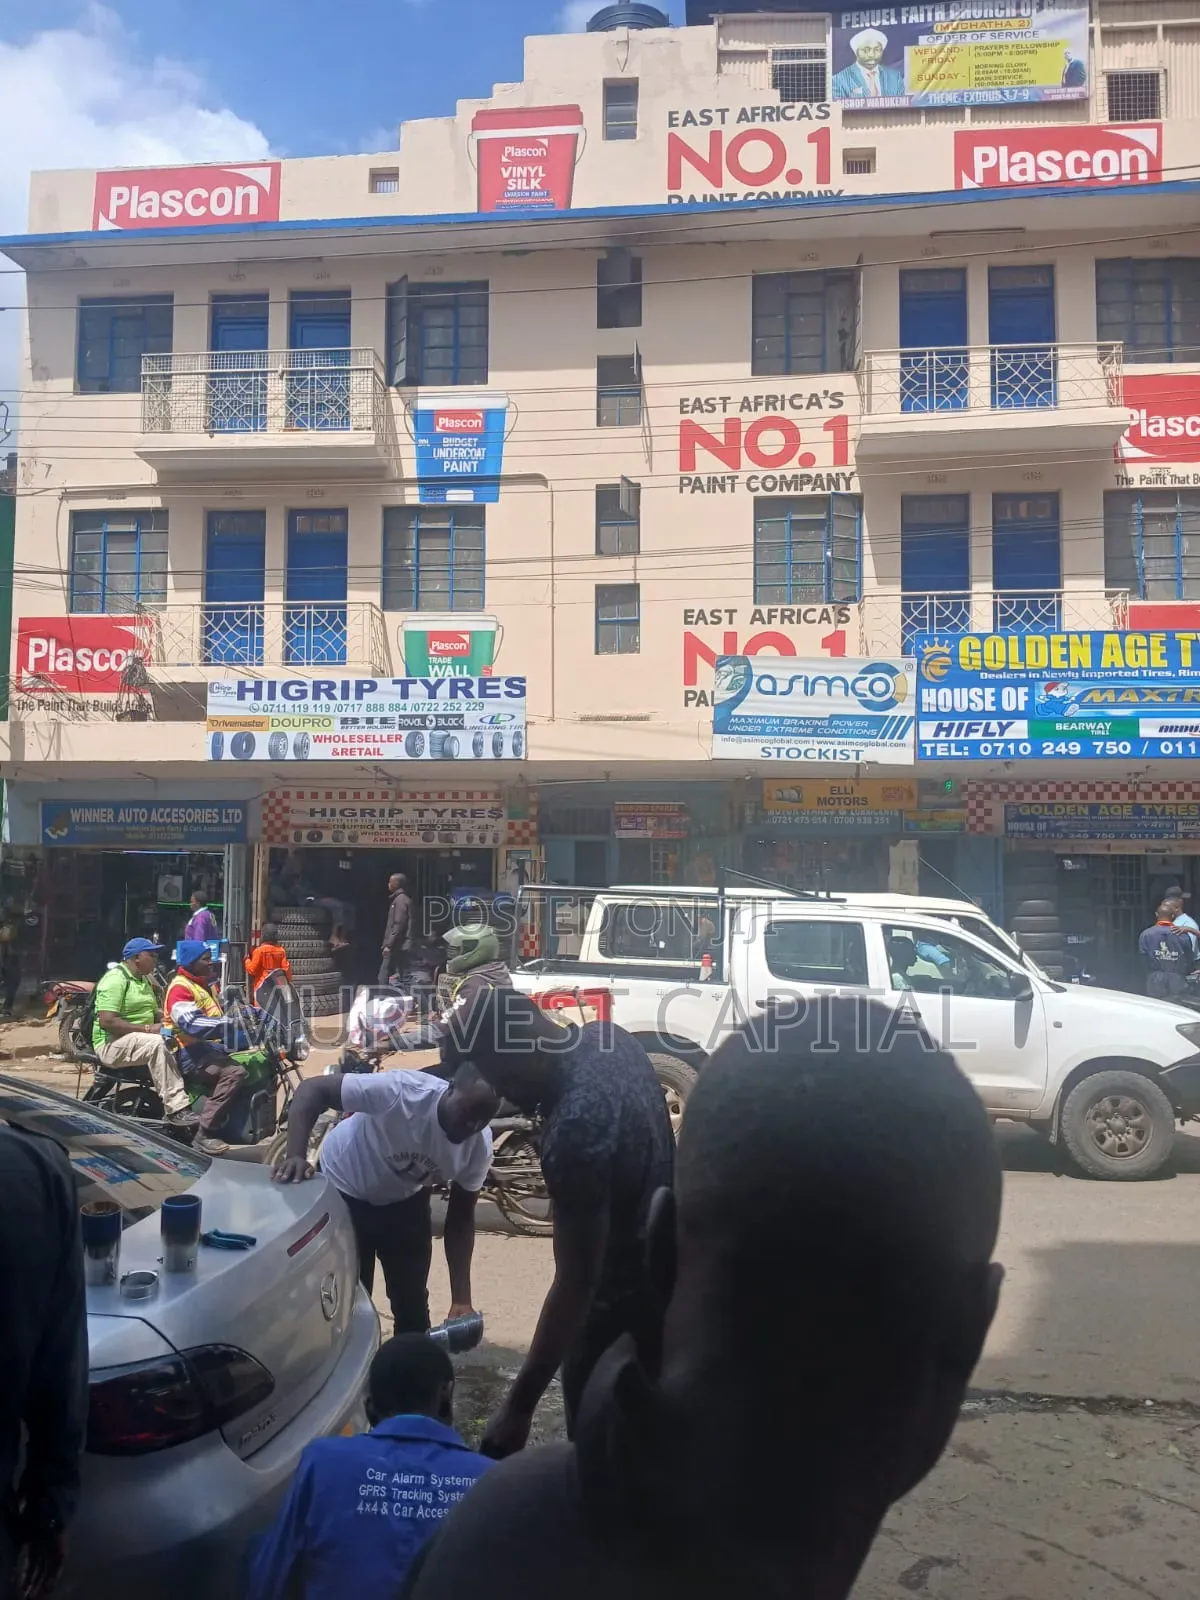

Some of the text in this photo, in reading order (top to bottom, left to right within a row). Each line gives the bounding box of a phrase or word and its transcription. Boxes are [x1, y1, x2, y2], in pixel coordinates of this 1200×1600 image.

[841, 8, 898, 29] PENUEL
[901, 2, 948, 24] FAITH
[927, 30, 1040, 43] ORDER OF SERVICE
[917, 73, 958, 82] SUNDAY
[840, 98, 865, 110] ISHOP
[668, 103, 831, 128] EAST AFRICA'S
[505, 146, 546, 157] Plascon
[667, 127, 831, 191] NO.1
[973, 146, 1148, 184] Plascon
[501, 166, 546, 178] VINYL
[507, 178, 542, 190] SILK
[109, 185, 259, 220] Plascon
[680, 390, 844, 414] EAST AFRICA'S
[438, 417, 482, 428] Plascon
[679, 414, 848, 472] NO.1
[443, 461, 478, 472] PAINT
[679, 472, 855, 494] PAINT COMPANY
[1115, 475, 1134, 486] The
[1169, 474, 1190, 485] That
[683, 606, 851, 625] EAST AFRICA'S
[431, 641, 467, 650] Plascon
[959, 632, 1200, 671] GOLDEN AGE T
[428, 665, 471, 677] WALL
[980, 671, 1026, 679] Dealers
[1029, 671, 1039, 679] in
[1141, 669, 1176, 677] Tires,
[237, 677, 526, 701] HIGRIP TYRES
[756, 674, 891, 698] asimco
[684, 690, 715, 707] PAI
[921, 686, 1029, 712] HOUSE OF
[17, 700, 35, 712] The
[263, 702, 484, 713] 0711 119 119 /0717 888 884 /0722 252 229
[211, 718, 265, 728] Drivemaster
[271, 718, 332, 728] DOUPRO
[729, 717, 869, 727] MAXIMUM BRAKING POWER
[1055, 722, 1112, 730] BEARWAY
[766, 726, 813, 734] EXTREME
[817, 727, 878, 736] CONDITIONS
[933, 721, 1015, 738] HIFLY
[312, 734, 402, 743] WHOLESELLER
[331, 747, 384, 756] &RETAIL
[760, 746, 864, 761] STOCKIST
[922, 740, 1197, 756] TEL: 0710 249 750 / 011
[830, 786, 854, 795] ELLI
[817, 796, 868, 806] MOTORS
[70, 807, 243, 824] WINNER AUTO ACCESORIES LTD
[309, 806, 504, 818] HIGRIP TYRES
[1019, 804, 1199, 816] GOLDEN AGE TYRES
[1037, 822, 1047, 832] OF
[366, 1468, 387, 1481] Car
[392, 1473, 425, 1484] Alarm
[359, 1484, 387, 1497] GPRS
[391, 1488, 433, 1503] Tracking
[356, 1500, 378, 1515] 4x4
[380, 1501, 388, 1515] &
[393, 1503, 413, 1517] Car
